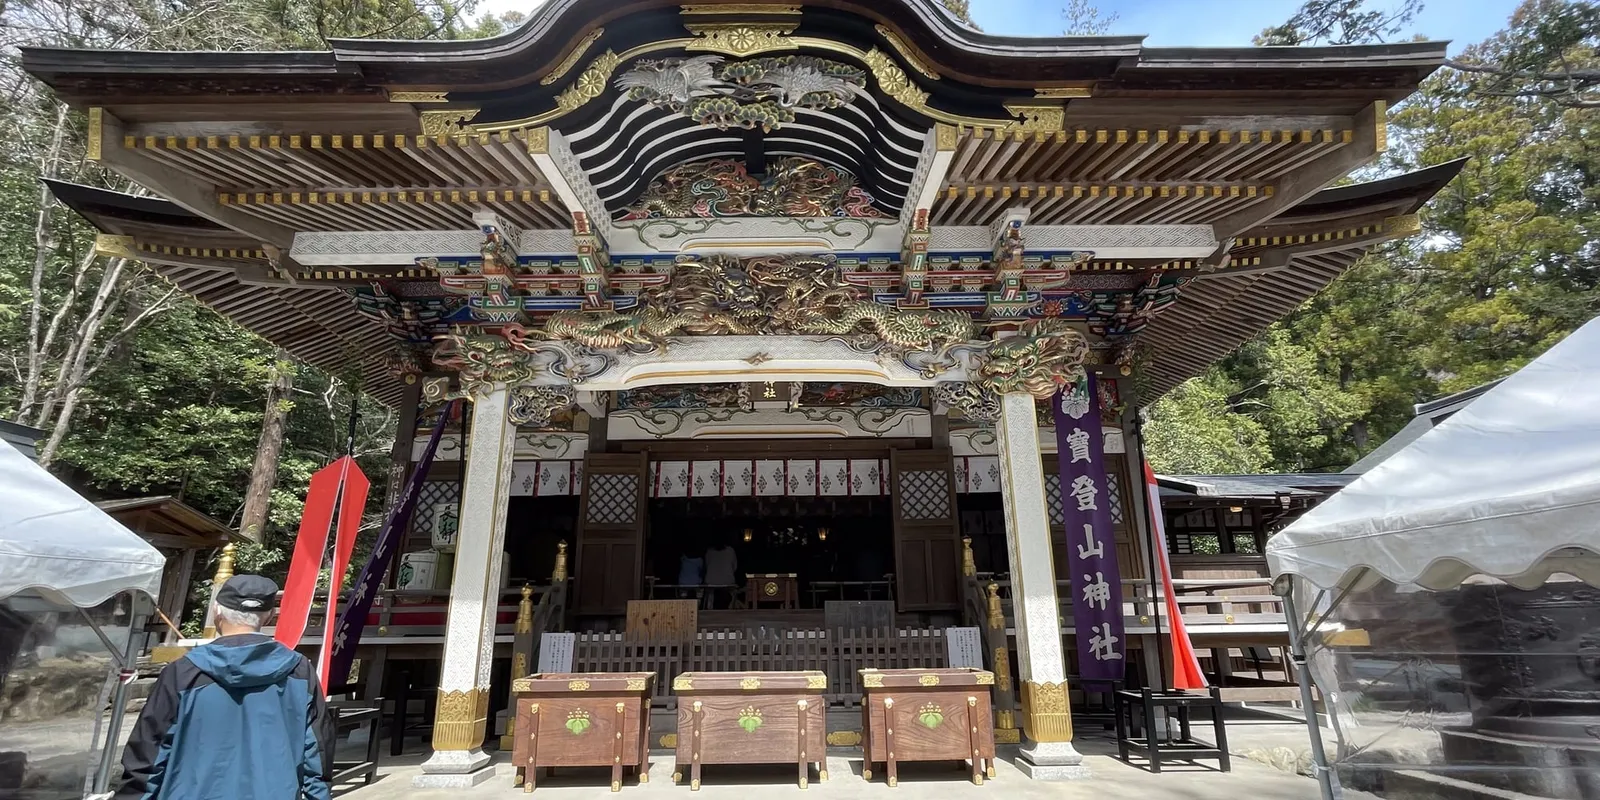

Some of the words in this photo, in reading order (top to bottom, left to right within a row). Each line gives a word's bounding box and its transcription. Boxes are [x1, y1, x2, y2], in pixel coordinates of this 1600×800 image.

[1066, 427, 1122, 662] 寶登山神社
